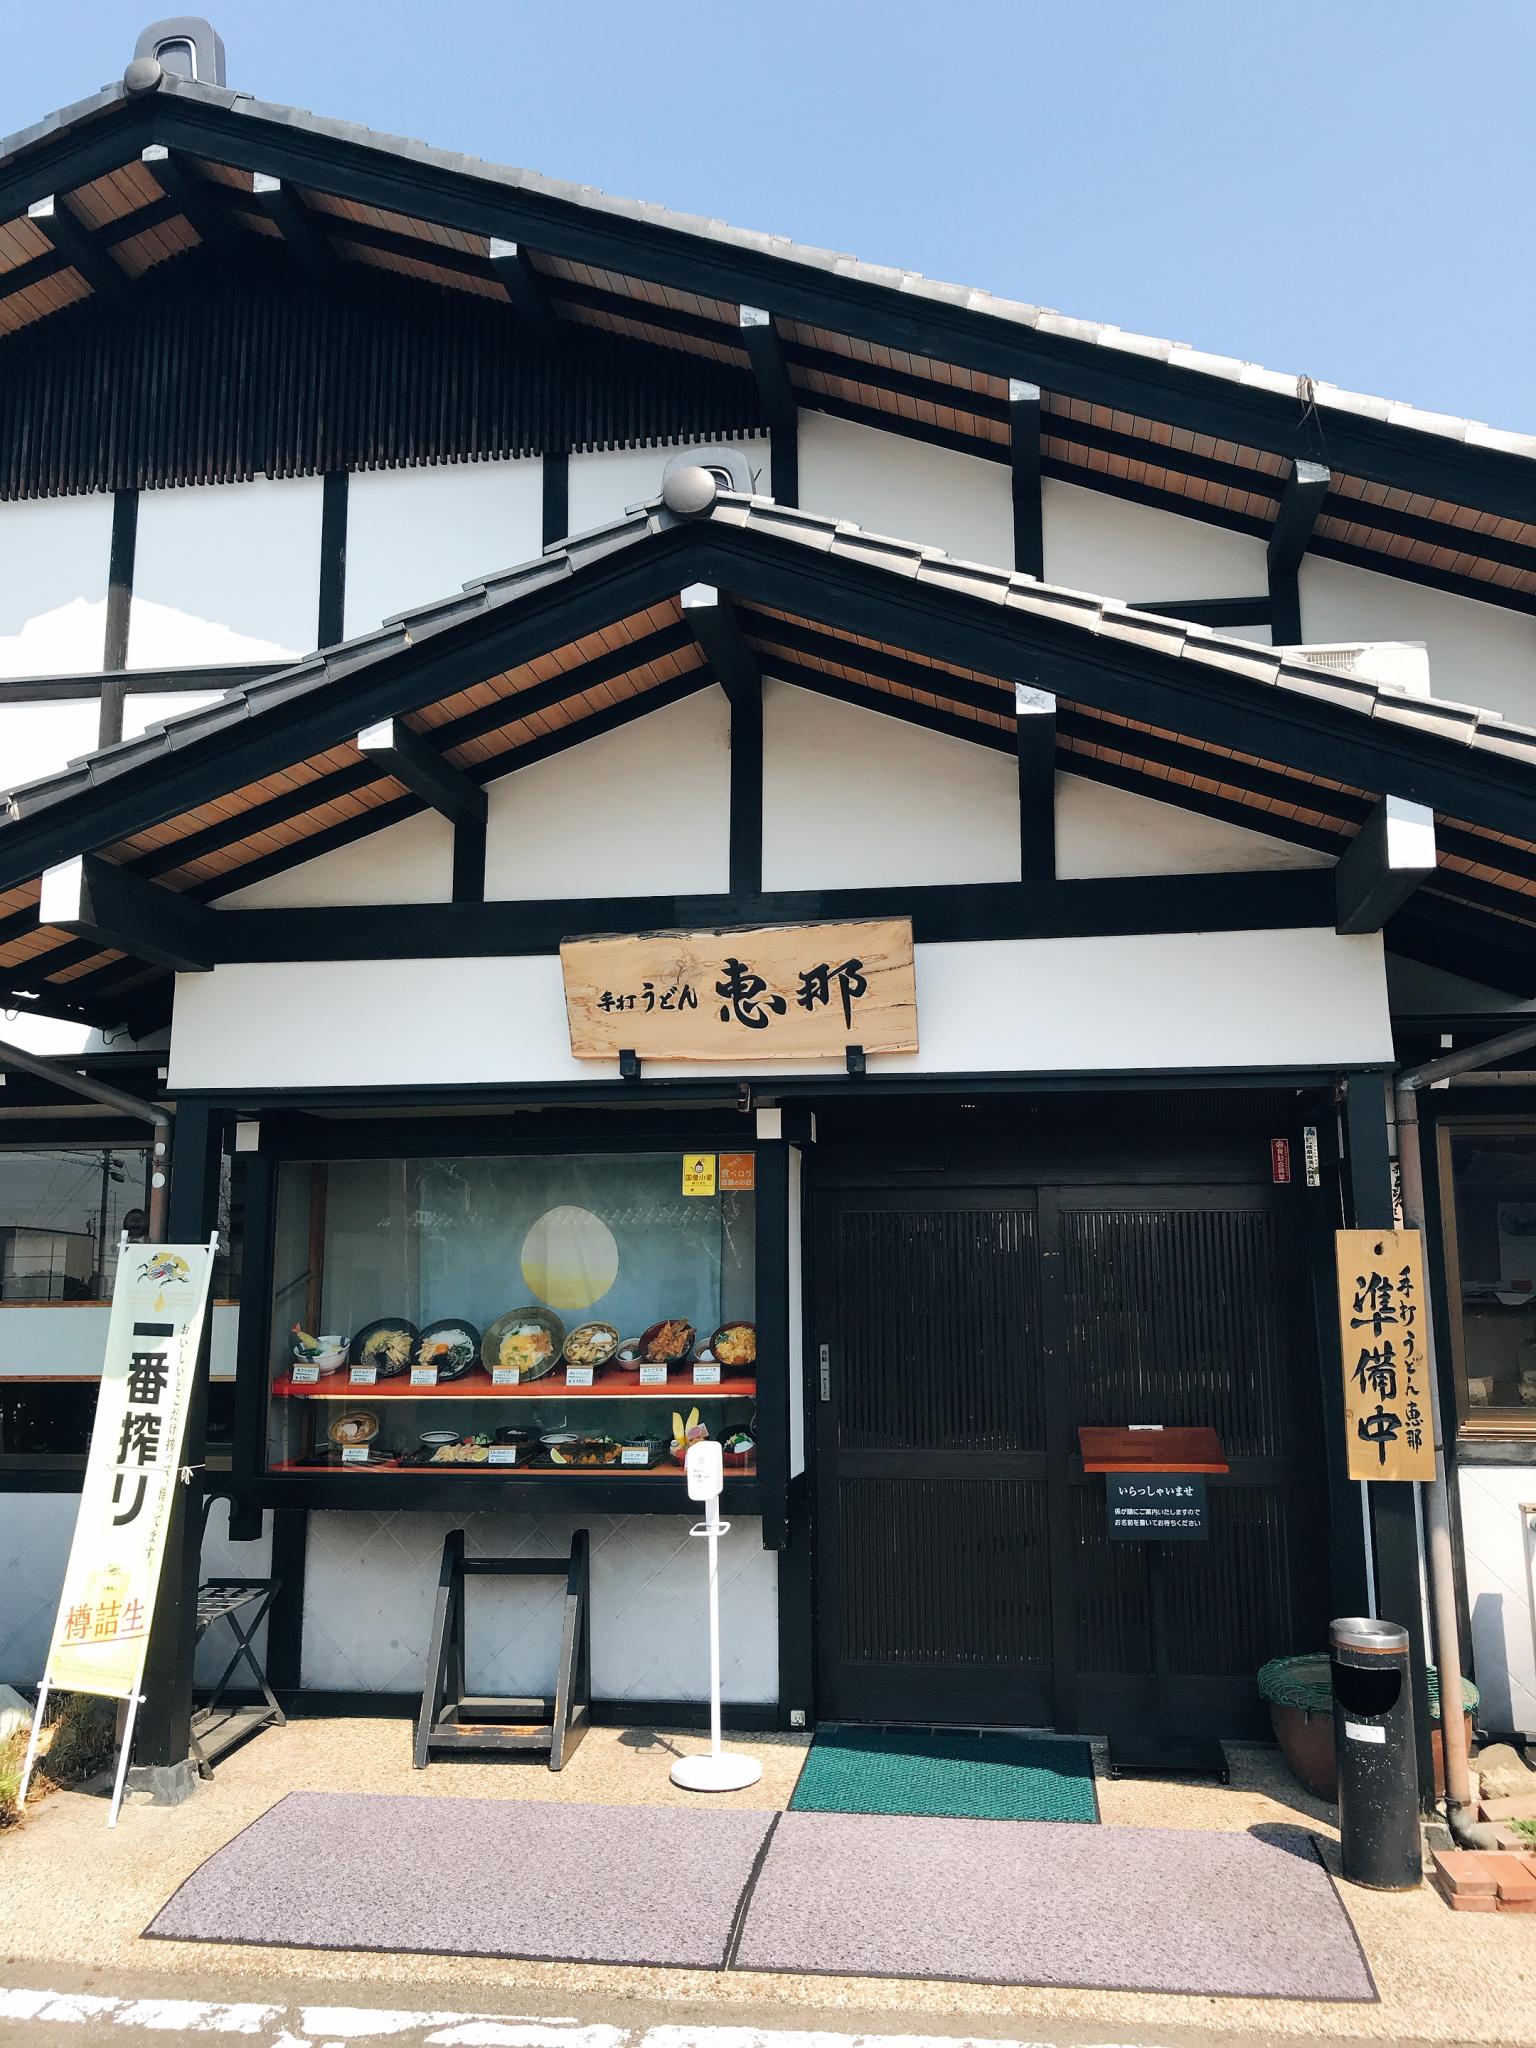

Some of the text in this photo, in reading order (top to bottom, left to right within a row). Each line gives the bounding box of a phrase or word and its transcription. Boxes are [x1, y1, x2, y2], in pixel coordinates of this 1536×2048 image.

[597, 958, 867, 1030] 手打うどん 恵那
[113, 1322, 174, 1527] 一番搾り
[1350, 1271, 1402, 1466] 準備中
[1397, 1265, 1423, 1454] 手打うどん 恵那
[1118, 1485, 1194, 1497] いらっしゃいませ
[64, 1598, 144, 1640] 樽詰生
